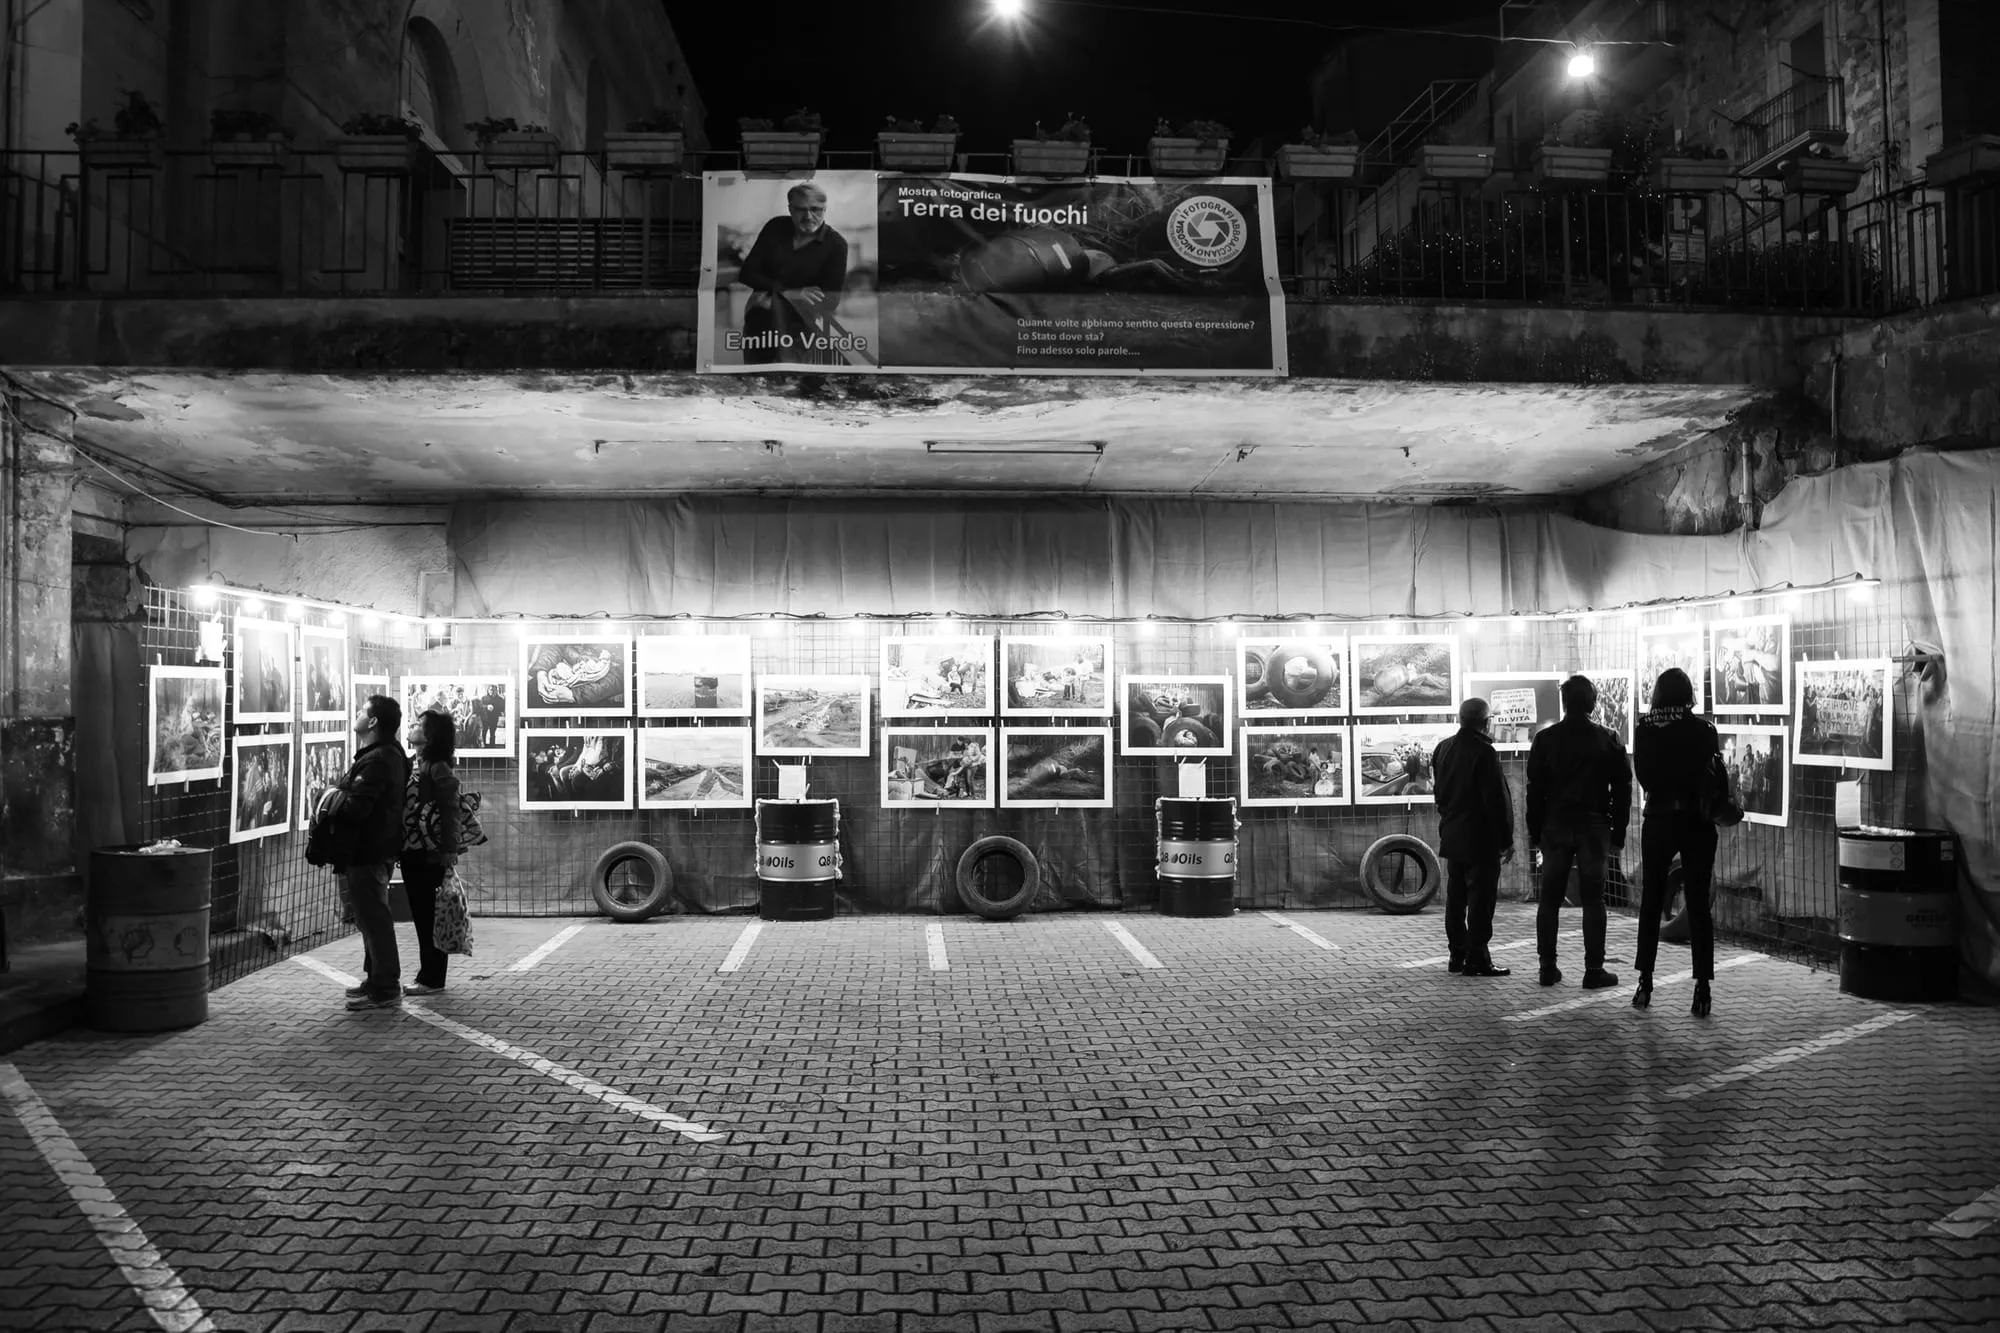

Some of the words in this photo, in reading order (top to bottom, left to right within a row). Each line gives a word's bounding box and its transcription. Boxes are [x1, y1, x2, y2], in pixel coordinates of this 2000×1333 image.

[899, 187, 937, 197] Mostra
[940, 188, 1001, 201] fotografica
[898, 199, 963, 218] Terra
[970, 203, 1007, 222] dei
[1013, 203, 1088, 225] fuochi
[1183, 201, 1234, 219] FOTOGRAFI
[1176, 220, 1196, 253] NICOSIA
[1196, 218, 1241, 258] ABBRACCIANO
[1017, 318, 1053, 328] Quante
[1054, 319, 1079, 328] volte
[1081, 319, 1124, 328] abbiamo
[1125, 320, 1159, 328] sentito
[1160, 320, 1193, 330] questa
[1195, 320, 1255, 331] espressione?
[726, 330, 794, 350] Emilio
[800, 331, 867, 350] Verde
[1018, 332, 1029, 341] Lo
[1031, 332, 1057, 341] Stato
[1059, 332, 1082, 341] dove
[1084, 332, 1105, 341] sta?
[1017, 345, 1038, 355] Fino
[1040, 345, 1073, 355] adesso
[1075, 346, 1096, 355] solo
[772, 856, 794, 868] Oils
[818, 855, 832, 867] Q8
[1179, 853, 1202, 864] Oils
